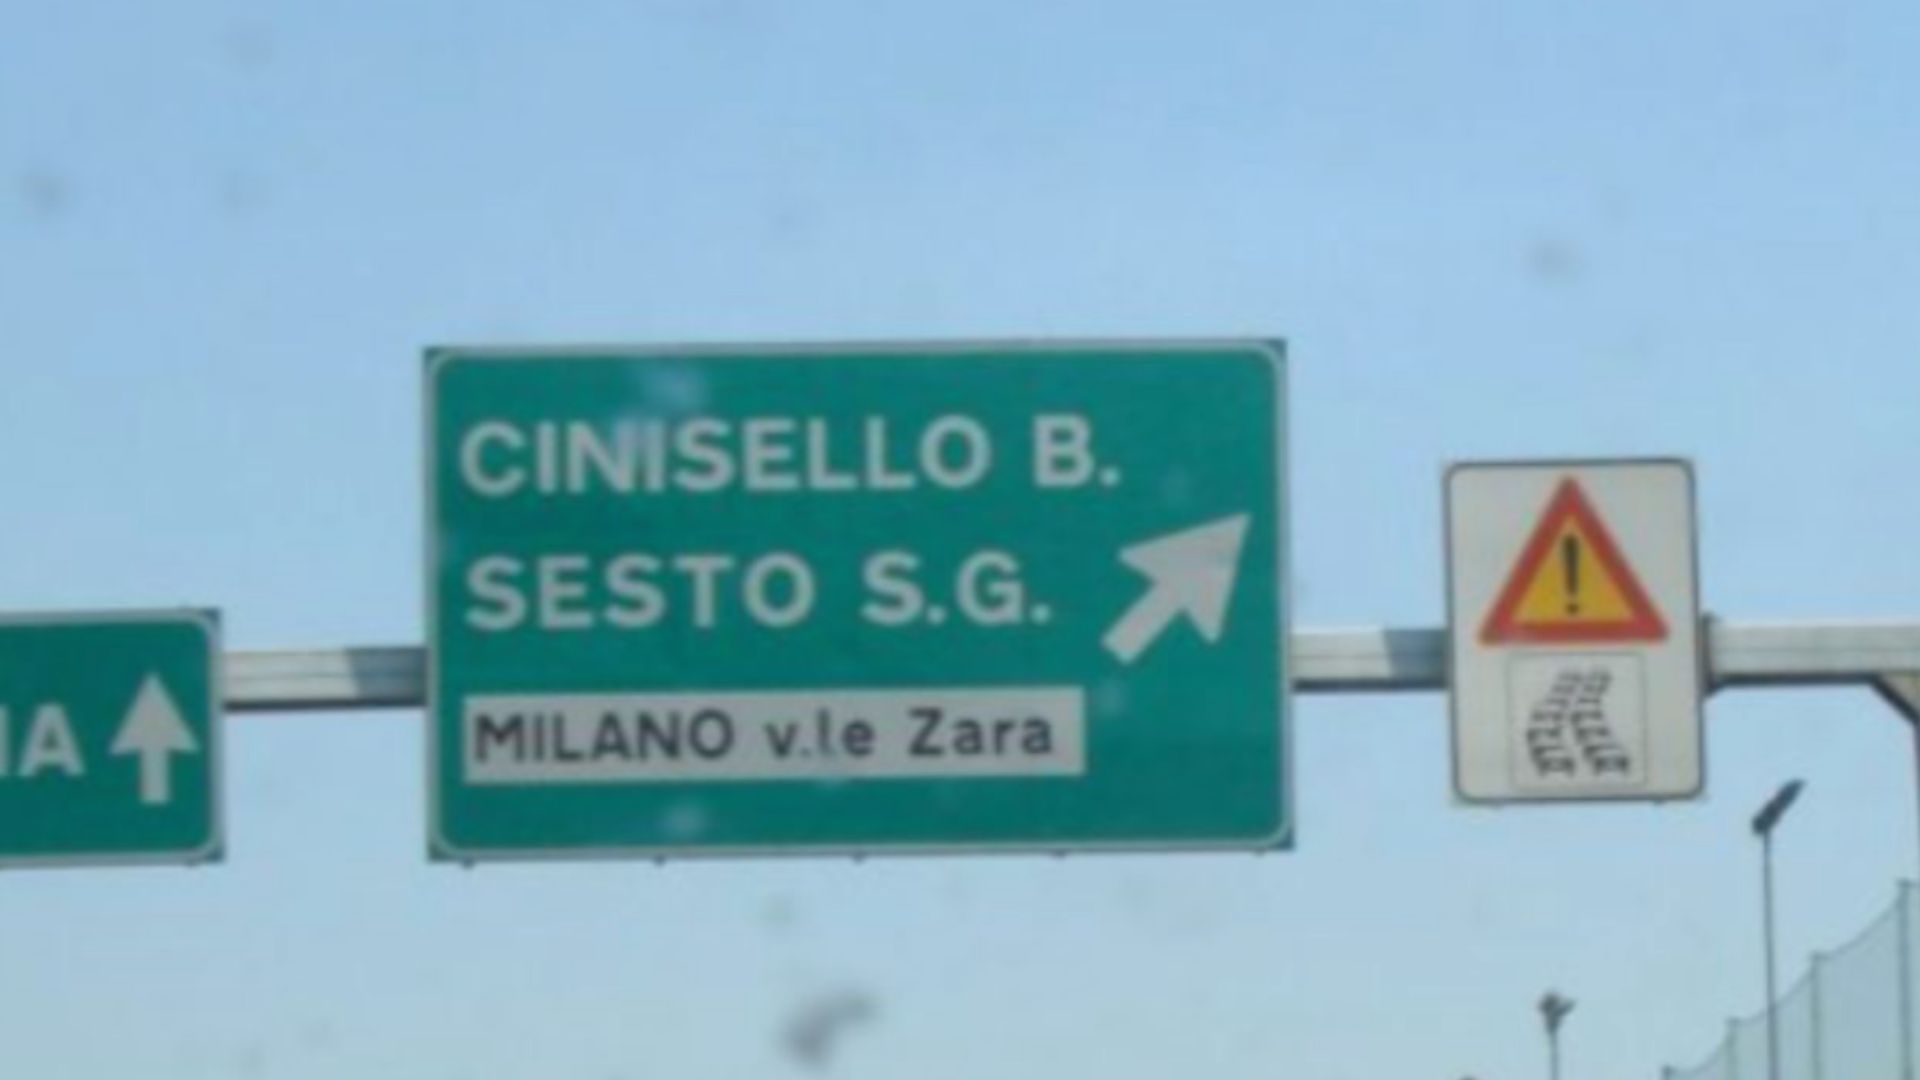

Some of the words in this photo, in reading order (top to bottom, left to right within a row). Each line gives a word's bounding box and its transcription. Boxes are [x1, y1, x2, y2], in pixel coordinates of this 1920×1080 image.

[460, 414, 992, 495] CINISELLO
[1031, 414, 1121, 490] B.
[464, 551, 817, 630] SESTO
[860, 550, 1052, 625] S.G.
[473, 710, 734, 763] MILANO
[764, 708, 876, 757] v.le
[908, 707, 1054, 757] Zara
